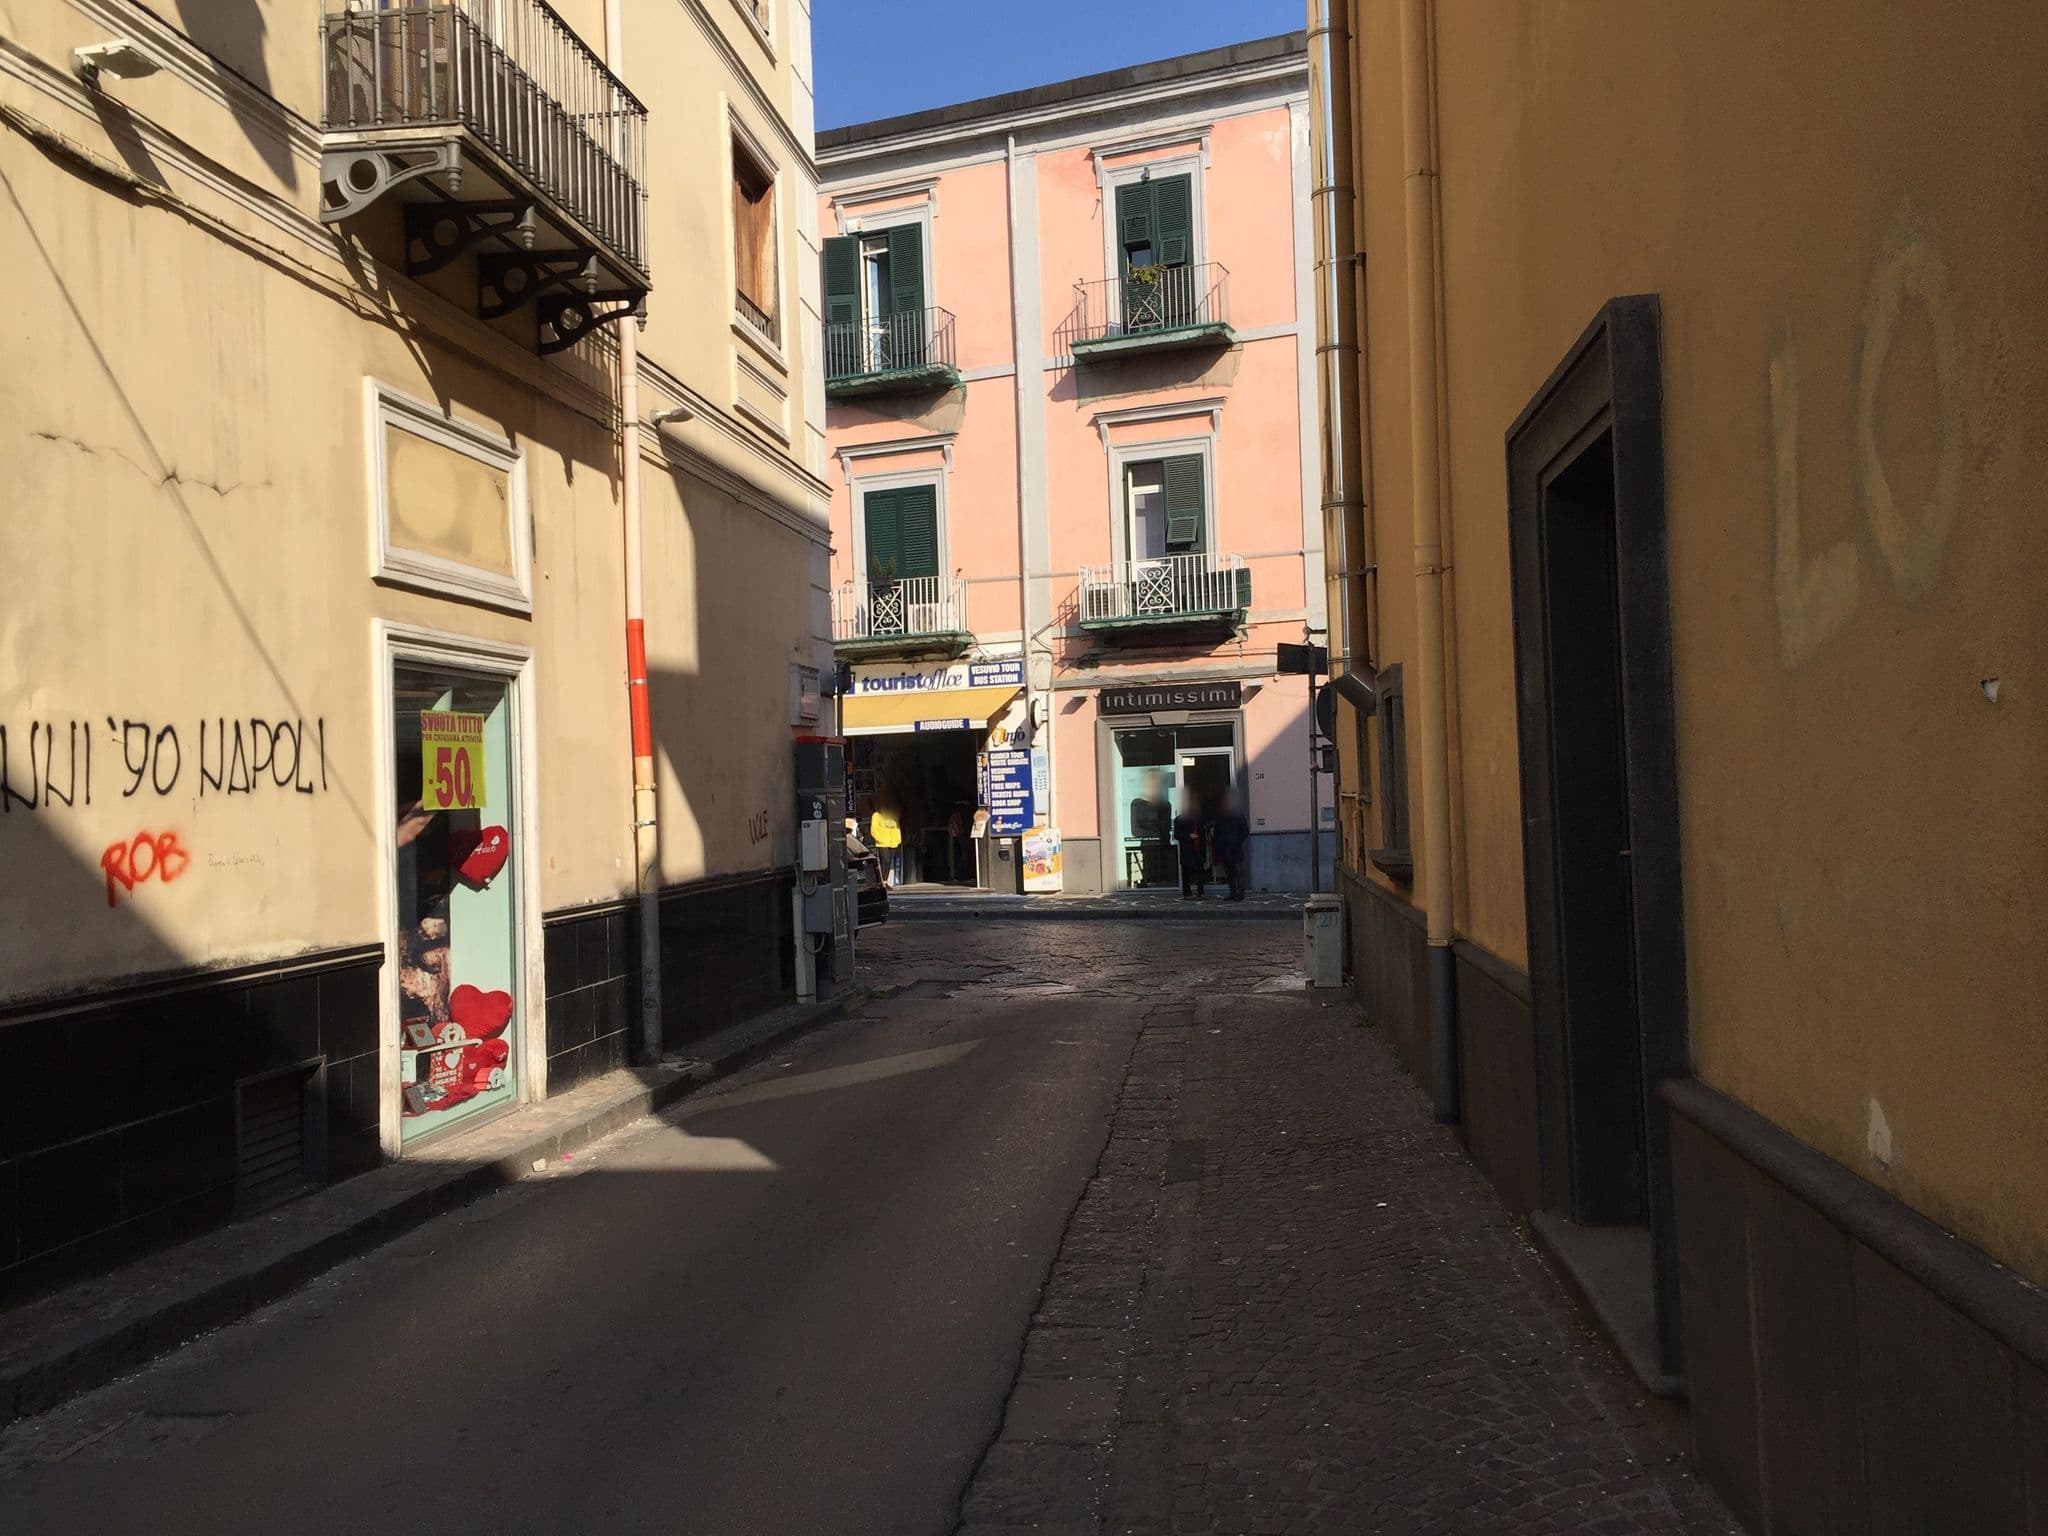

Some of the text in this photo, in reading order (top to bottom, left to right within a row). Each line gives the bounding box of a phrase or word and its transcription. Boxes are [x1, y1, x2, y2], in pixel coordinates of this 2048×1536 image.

[971, 662, 1020, 674] VESUVIO TOUR
[974, 673, 1019, 685] BUS STATION
[1106, 688, 1235, 708] intimissimi
[422, 712, 483, 734] SVUOTA TUTTO
[920, 718, 965, 731] AUDIOGUIDE
[200, 717, 327, 797] NAPOLI
[101, 831, 189, 909] ROB
